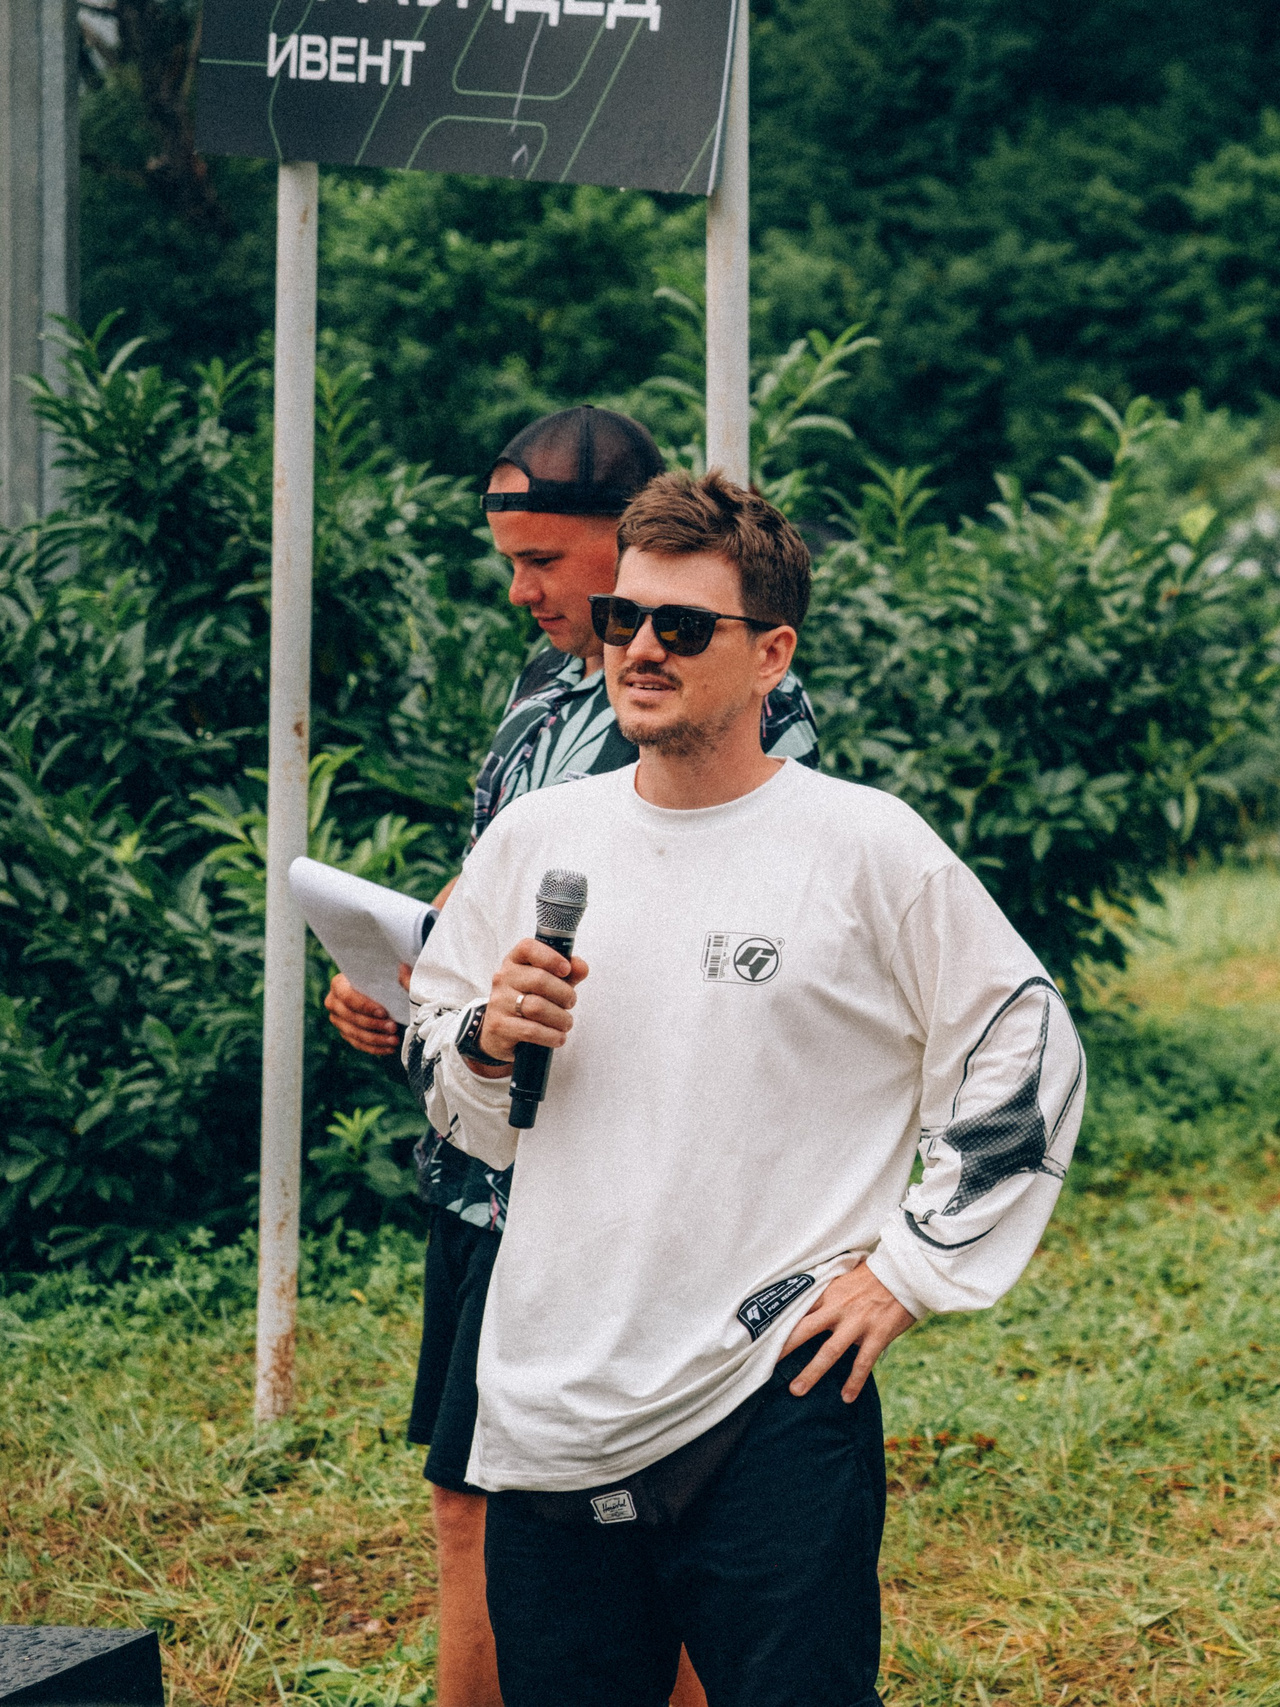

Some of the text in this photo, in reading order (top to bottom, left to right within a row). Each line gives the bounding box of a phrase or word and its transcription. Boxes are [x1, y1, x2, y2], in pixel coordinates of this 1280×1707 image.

[267, 33, 426, 87] ИВЕНТ
[767, 1278, 808, 1312] FOR RECKLESS
